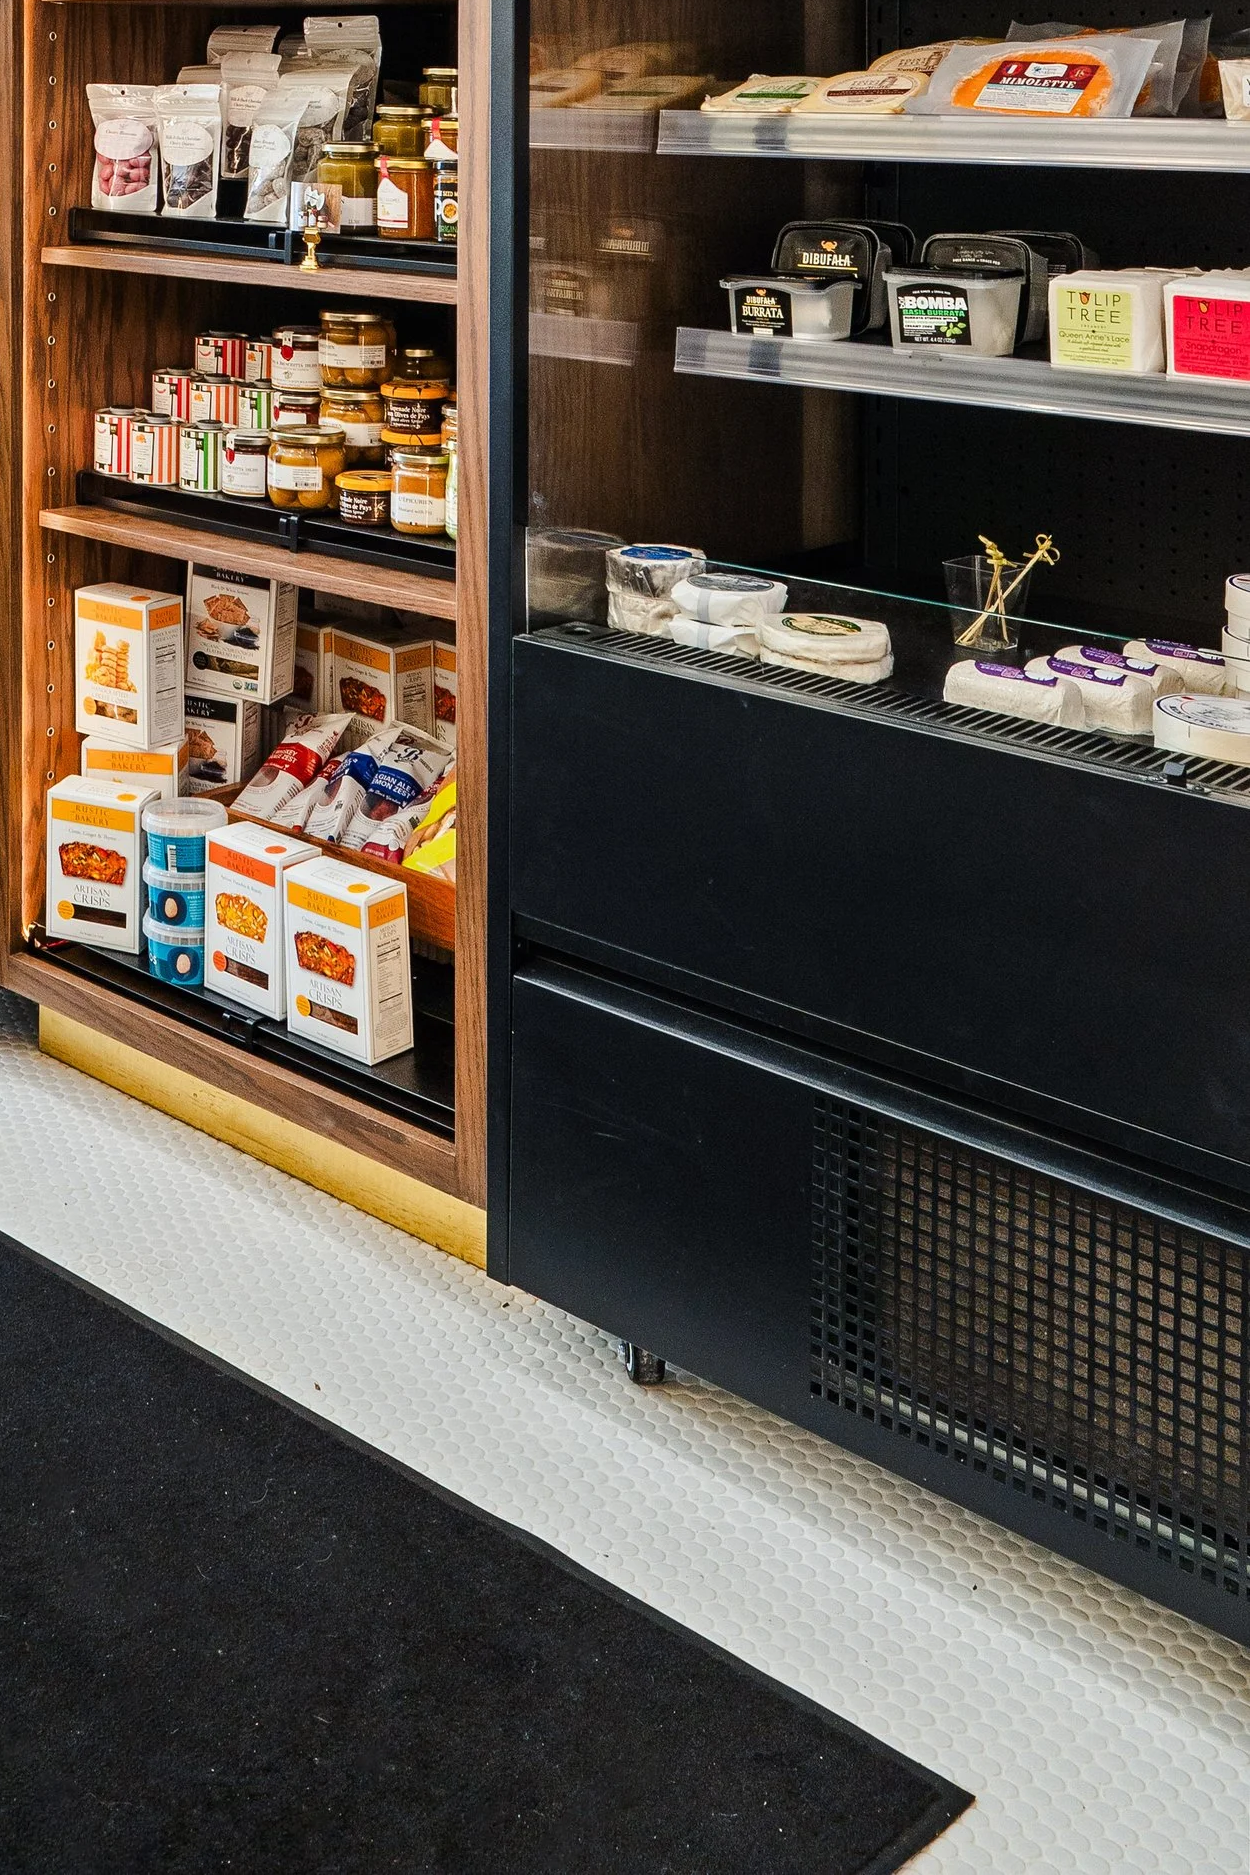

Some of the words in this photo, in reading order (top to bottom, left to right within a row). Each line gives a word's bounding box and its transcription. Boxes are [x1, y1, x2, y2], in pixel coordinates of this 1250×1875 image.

[999, 76, 1077, 89] MIMOLETTE
[803, 253, 851, 267] DIBUFALA
[746, 296, 776, 305] DIBUFALA
[904, 296, 968, 311] BOMBA
[1067, 290, 1121, 307] TULIP
[742, 306, 784, 319] BURRATA
[927, 309, 966, 317] BURRATA
[1185, 299, 1243, 317] TULIP
[1067, 307, 1121, 324] TREE
[1186, 316, 1243, 335] TREE
[1059, 330, 1084, 339] Queen
[1085, 333, 1110, 341] Anne's
[1111, 335, 1130, 343] Lace
[1185, 341, 1242, 354] Snapdragon
[417, 412, 430, 420] Pays
[359, 504, 372, 512] Pays
[216, 572, 244, 583] BAKERY
[111, 753, 147, 762] RUSTIC
[111, 762, 148, 771] BAKERY
[392, 786, 411, 799] ZEST
[397, 780, 412, 792] ALE
[76, 804, 109, 817] RUSTIC
[75, 814, 109, 826] BAKERY
[227, 850, 254, 863] RUSTIC
[227, 860, 256, 877] BAKERY
[73, 884, 111, 898] ARTISAN
[73, 893, 111, 908] CRISPS
[307, 890, 337, 907] RUSTIC
[307, 900, 339, 918] BAKERY
[226, 935, 256, 954] ARTISAN
[225, 945, 256, 965] CRISPS
[310, 978, 343, 998] ARTISAN
[309, 987, 343, 1008] CRISPS
